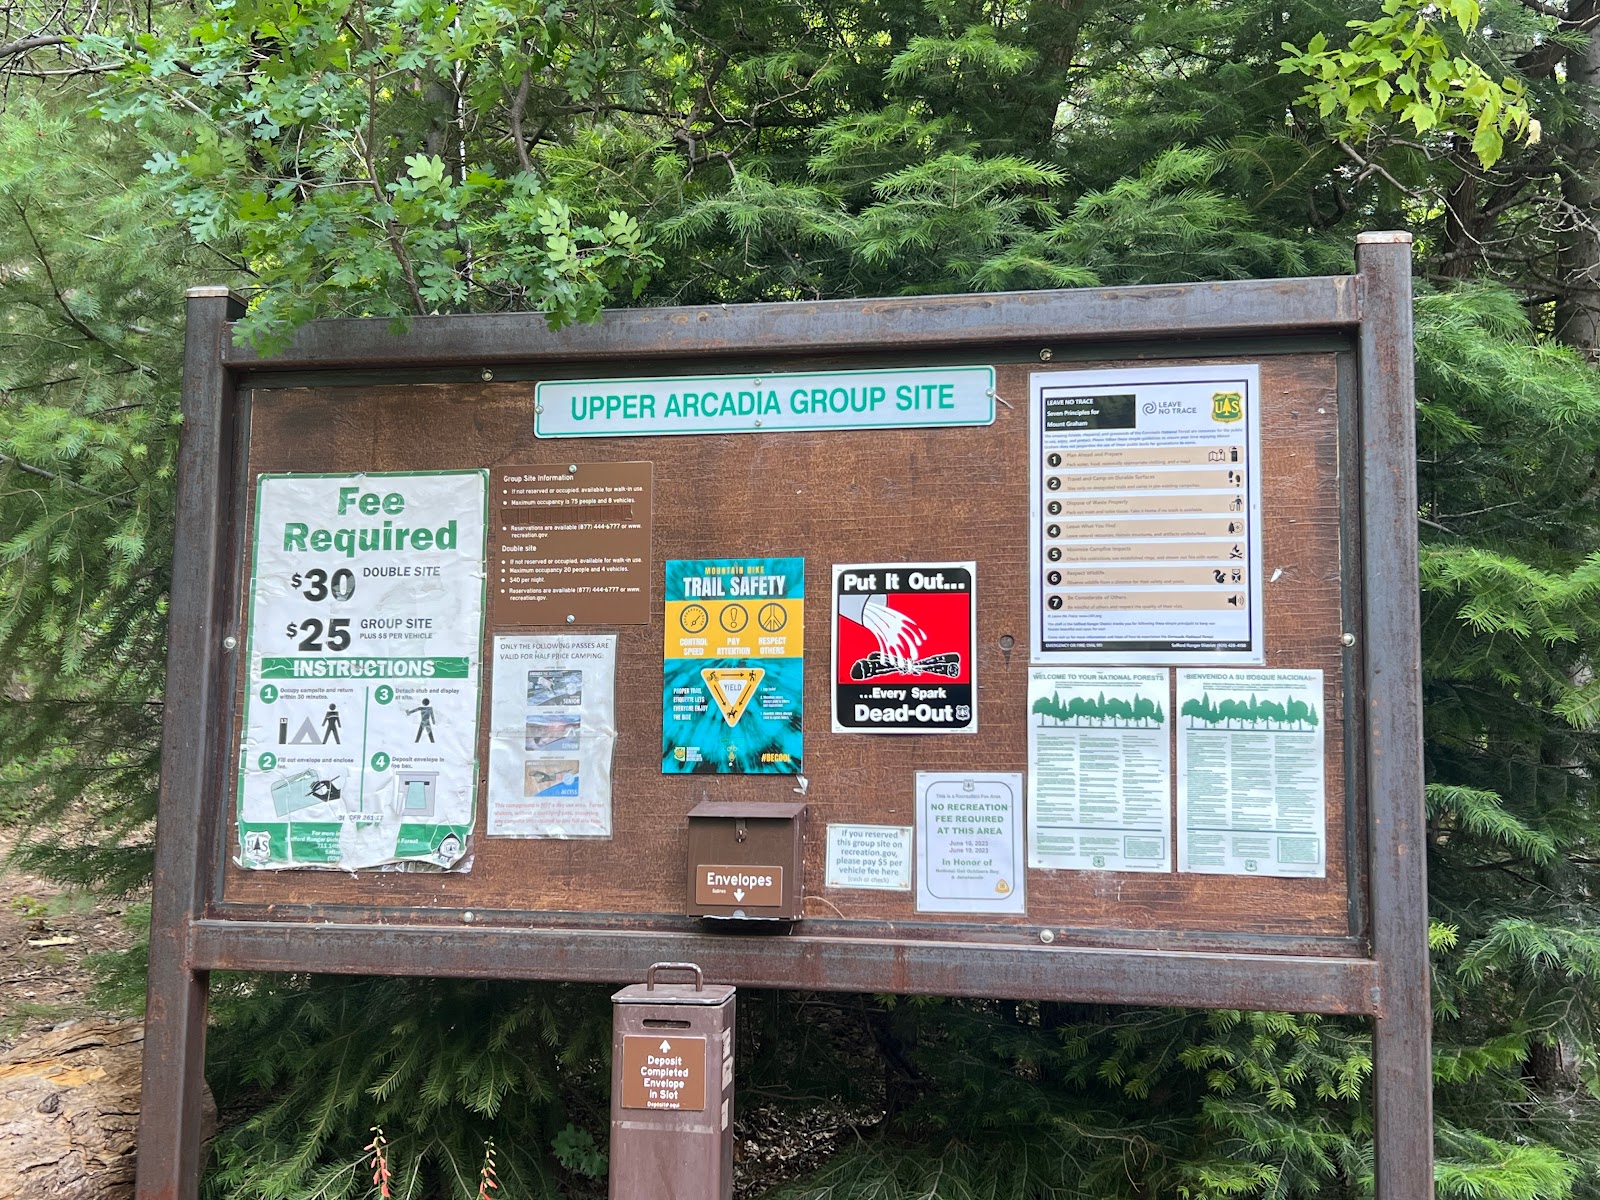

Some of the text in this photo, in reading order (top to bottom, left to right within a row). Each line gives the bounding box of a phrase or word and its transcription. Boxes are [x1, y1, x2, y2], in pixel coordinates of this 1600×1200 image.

[571, 384, 954, 420] UPPER ARCADIA GROUP SITE
[1064, 409, 1089, 417] Principles
[1052, 455, 1057, 464] 1
[504, 475, 522, 483] Group
[338, 487, 405, 515] Fee
[1051, 504, 1058, 513] 3
[1050, 527, 1058, 535] 4
[283, 520, 457, 557] Required
[1051, 550, 1058, 559] 5
[364, 567, 440, 577] DOUBLE SITE
[748, 566, 764, 574] BIKE
[844, 572, 965, 590] Put It Out...
[1051, 574, 1058, 582] 6
[291, 568, 356, 602] $30
[683, 576, 786, 596] TRAIL SAFETY
[1052, 599, 1058, 607] 7
[361, 619, 432, 629] GROUP SITE
[286, 618, 351, 651] $25
[680, 638, 708, 646] CONTROL
[294, 660, 435, 677] INSTRUCTIONS
[264, 688, 273, 699] 1
[380, 689, 388, 699] 3
[860, 687, 946, 700] ...Every Spark
[855, 704, 953, 722] Dead-Out
[263, 757, 271, 767] 2
[376, 756, 385, 767] 4
[762, 754, 791, 762] #BECOOL
[849, 831, 863, 839] you
[852, 840, 875, 848] group
[841, 849, 898, 858] recreation.gov,
[837, 858, 861, 866] please
[863, 859, 876, 867] pay
[878, 858, 887, 866] $5
[839, 866, 899, 876] vehicle fee here
[707, 872, 772, 889] Envelopes
[648, 1056, 682, 1066] Deposit
[641, 1067, 688, 1078] Completed
[644, 1078, 684, 1089] Envelope
[660, 1090, 678, 1099] Slot
